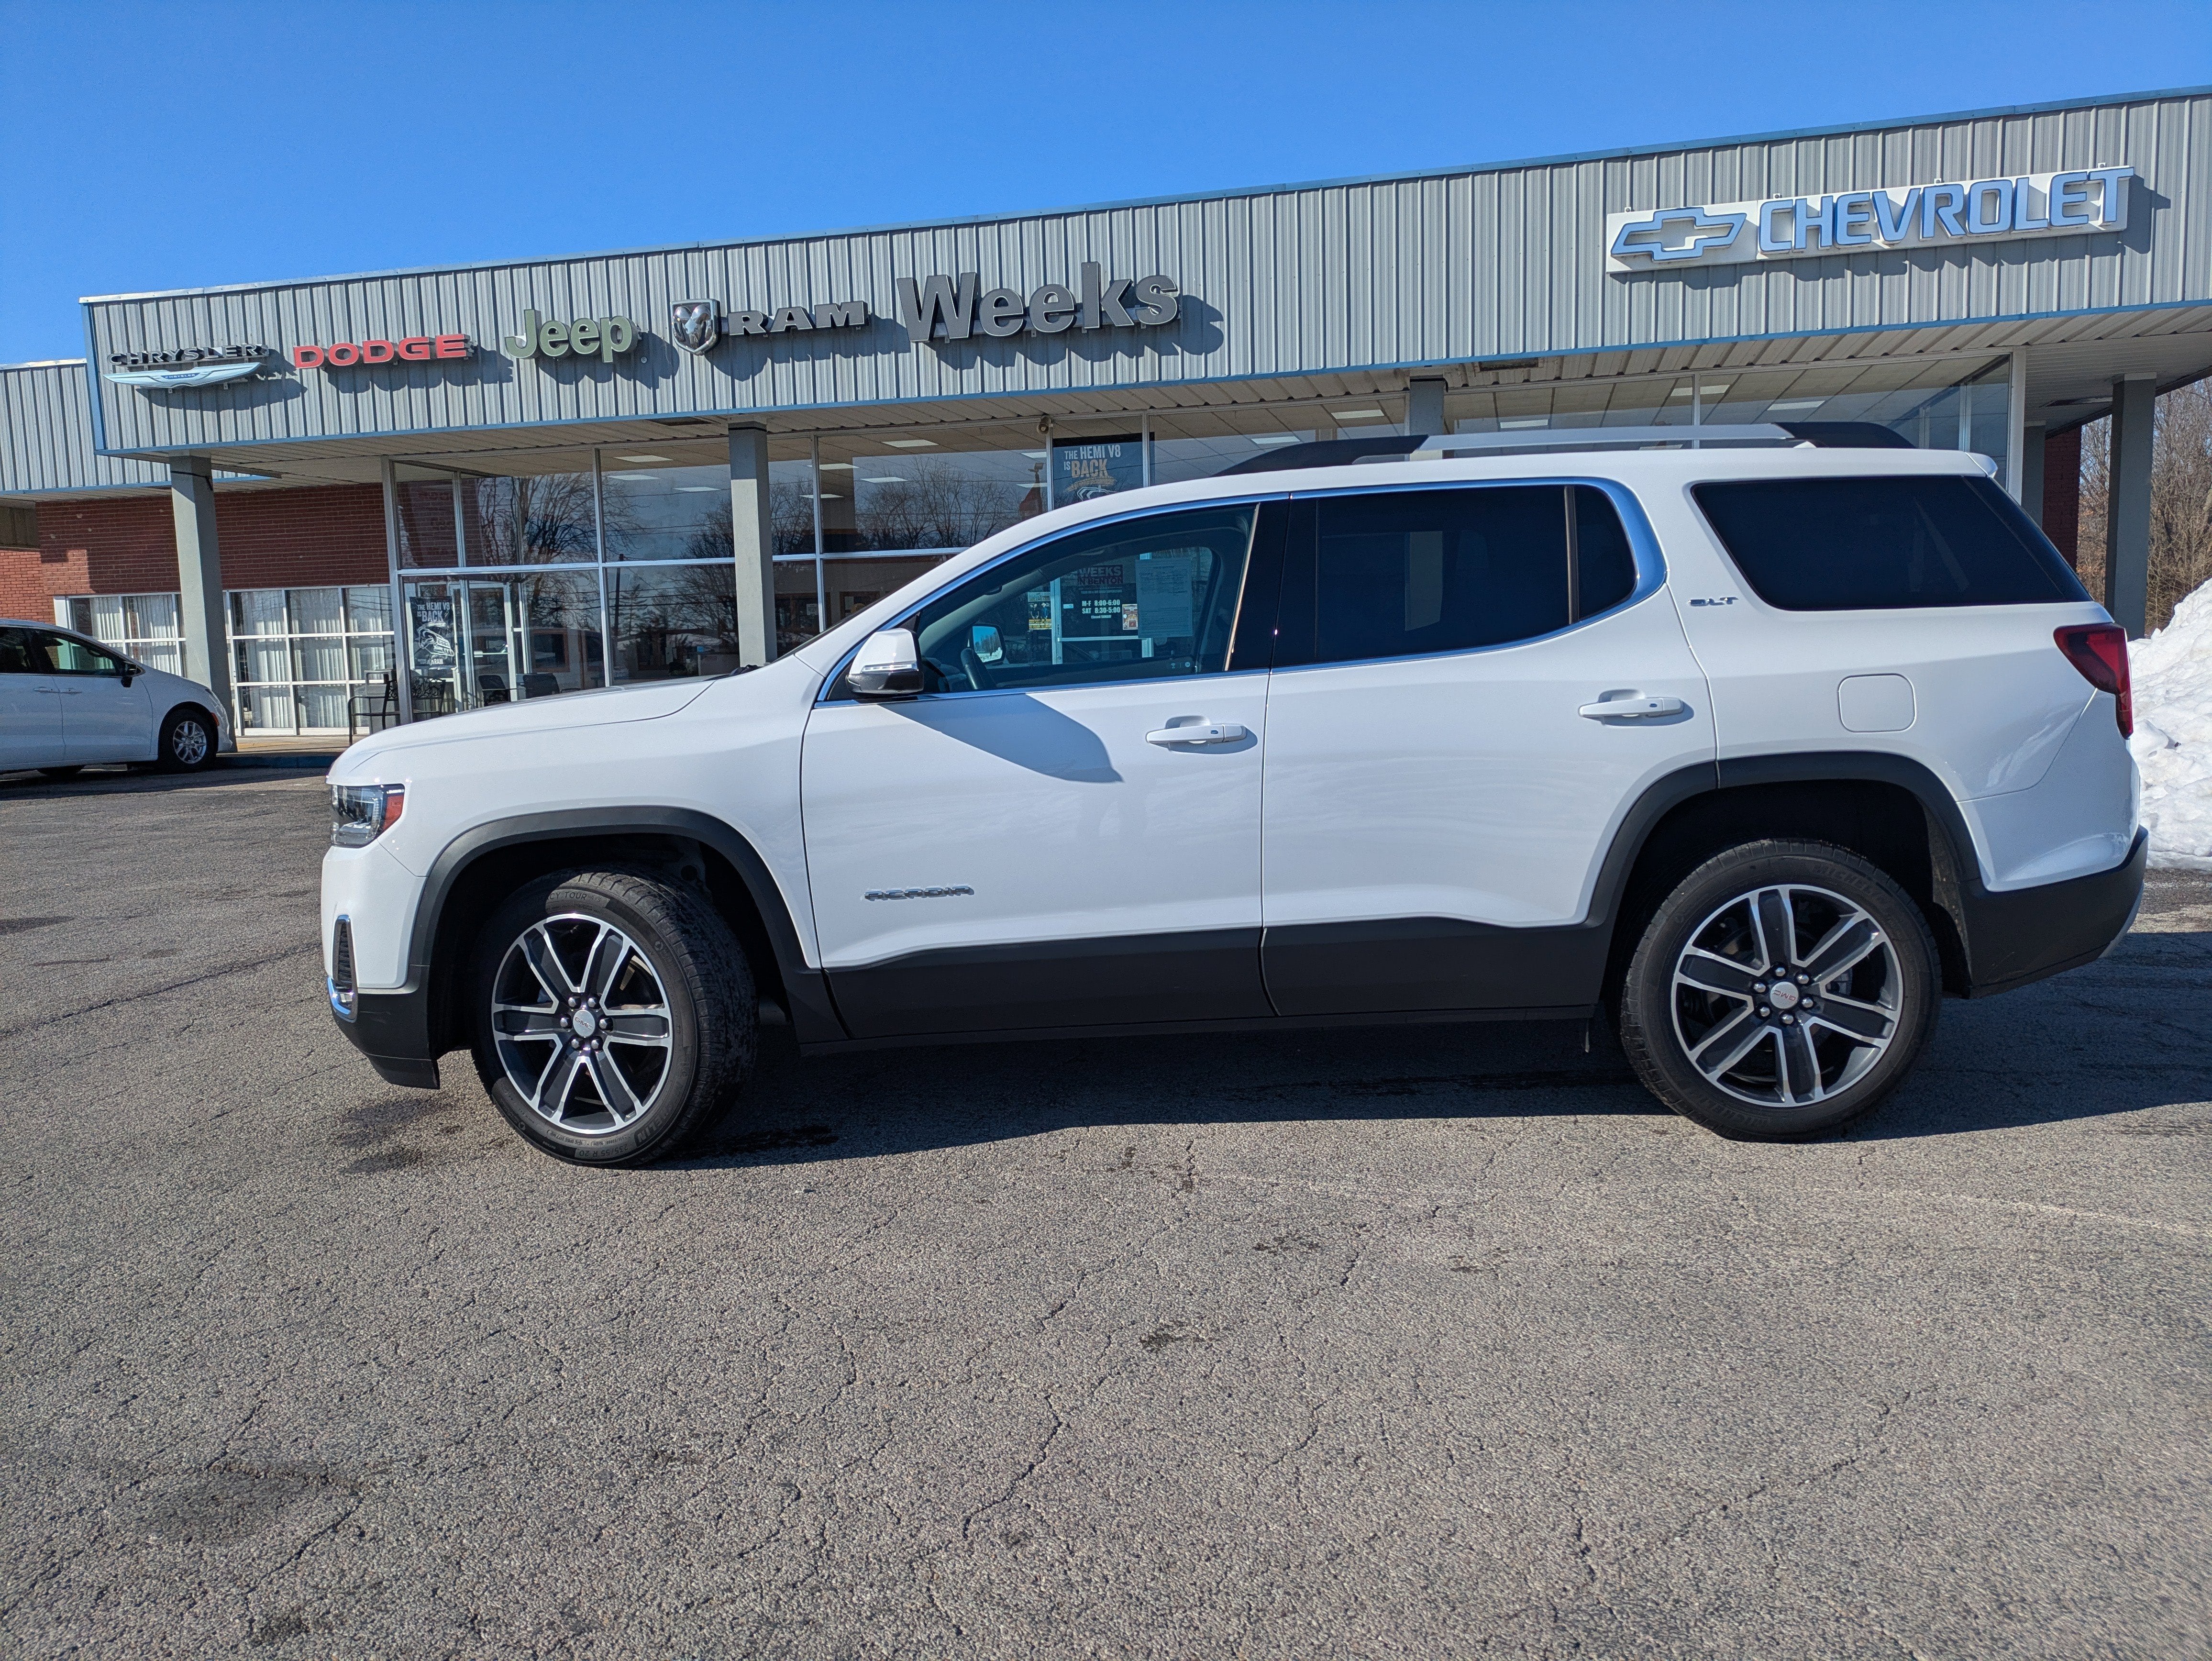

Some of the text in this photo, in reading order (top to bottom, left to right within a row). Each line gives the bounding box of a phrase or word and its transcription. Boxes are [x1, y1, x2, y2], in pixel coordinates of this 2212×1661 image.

[1758, 166, 2135, 254] CHEVROLET
[896, 261, 1179, 343] Weeks
[728, 300, 866, 336] RAM
[505, 309, 637, 363] Jeep
[107, 343, 261, 366] CHRYSLER
[293, 333, 468, 369] DODGE
[1064, 444, 1121, 460] THE HEMI V8
[1063, 458, 1108, 478] IS BACK
[426, 602, 442, 610] HEMI
[421, 610, 444, 622] BACK
[564, 891, 587, 900] TOUR
[864, 886, 970, 900] ACADIA
[1773, 989, 1796, 1001] GMC
[575, 1017, 593, 1030] GMC
[600, 1143, 629, 1157] 235/55
